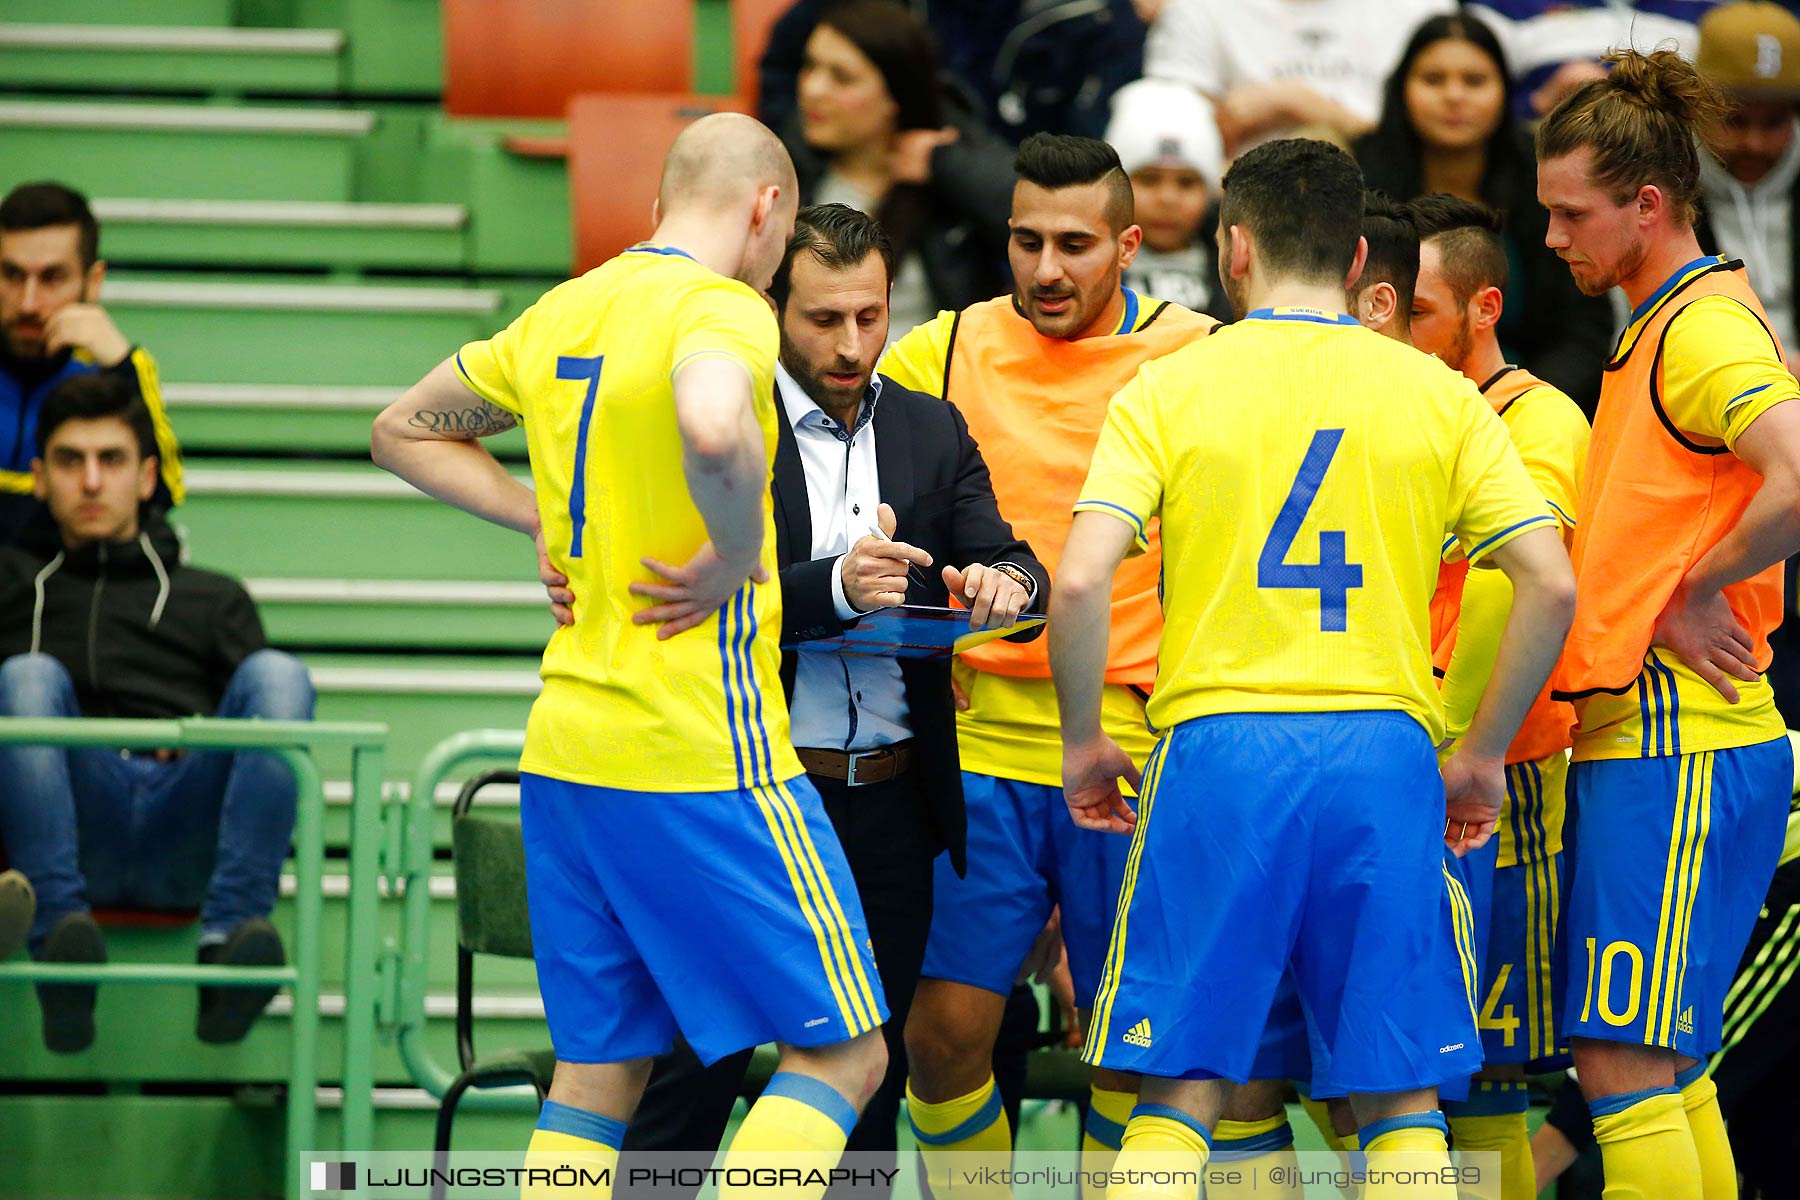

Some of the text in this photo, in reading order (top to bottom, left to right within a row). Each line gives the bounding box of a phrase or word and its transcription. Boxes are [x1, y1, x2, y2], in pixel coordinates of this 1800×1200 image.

[556, 355, 604, 558] 7
[1257, 428, 1364, 632] 4
[1479, 963, 1520, 1047] 4
[1580, 937, 1644, 1027] 10
[1122, 1033, 1153, 1049] adidas
[1439, 1043, 1464, 1054] adizero
